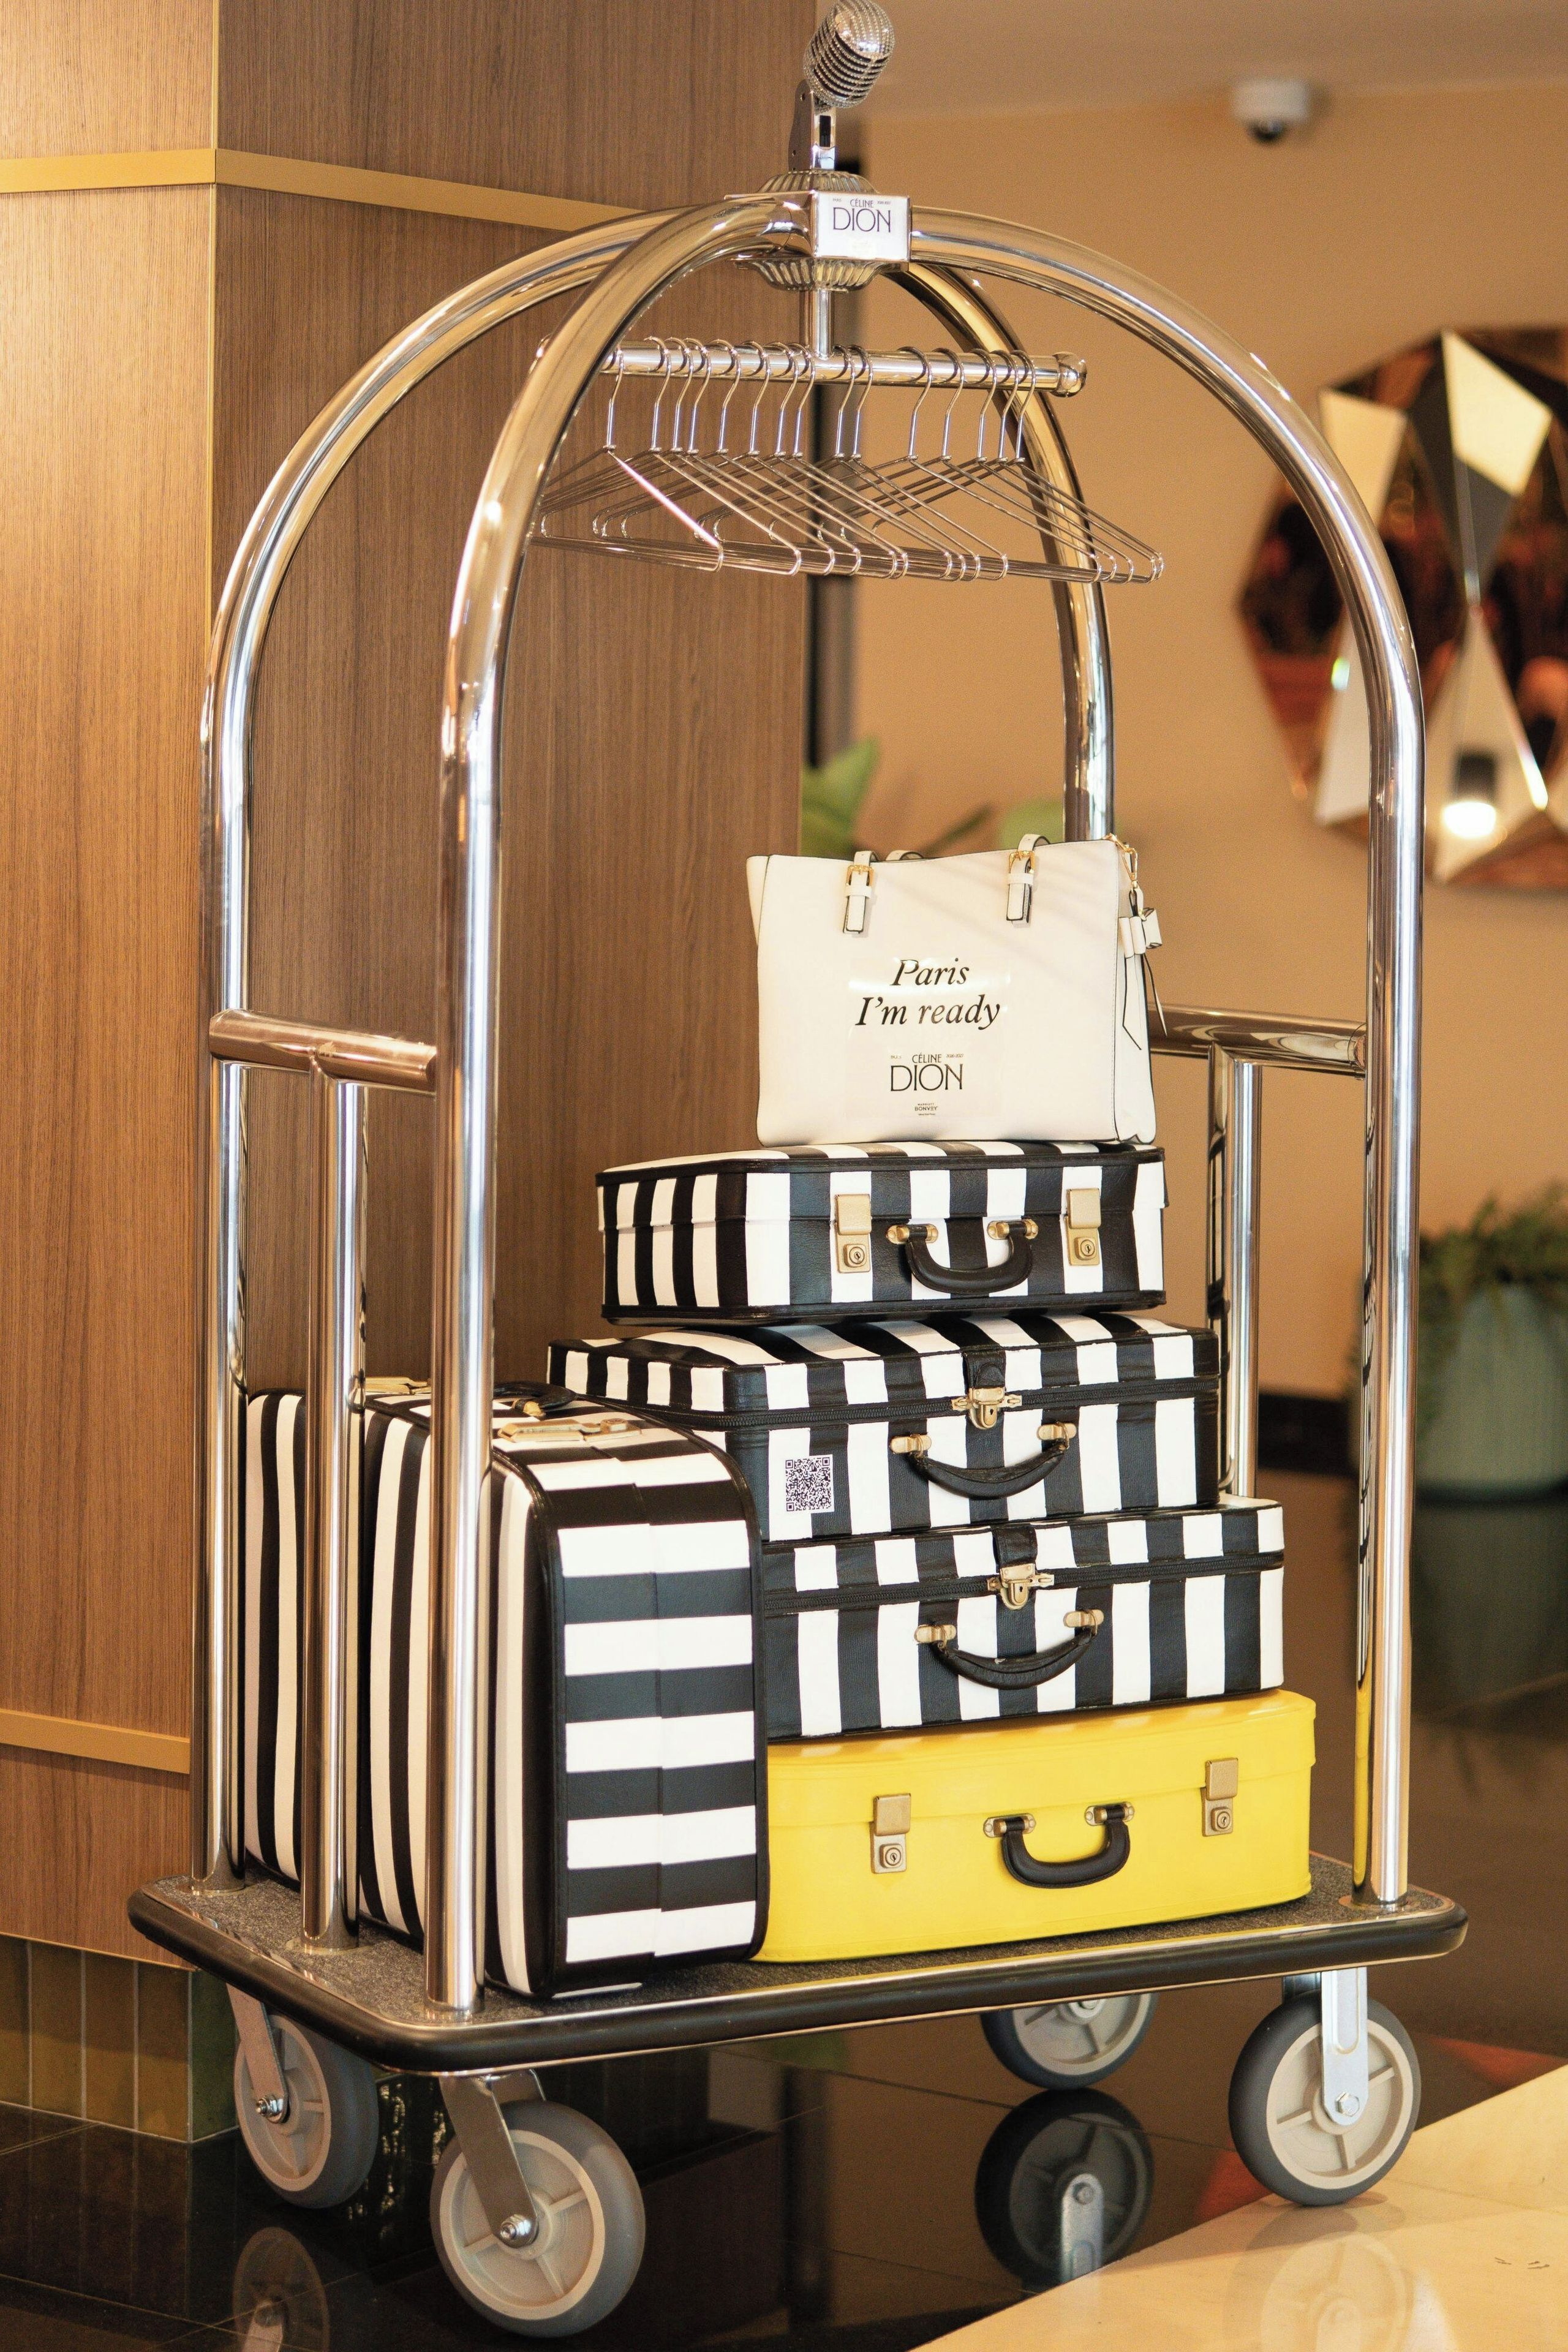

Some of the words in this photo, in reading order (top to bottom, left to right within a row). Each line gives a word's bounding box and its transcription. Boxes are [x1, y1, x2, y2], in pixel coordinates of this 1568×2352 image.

[850, 198, 873, 208] CÉLINE
[833, 207, 891, 233] DION
[889, 957, 970, 986] Paris
[918, 993, 1000, 1030] ready
[911, 1052, 942, 1063] CÉLINE
[891, 1063, 963, 1091] DION
